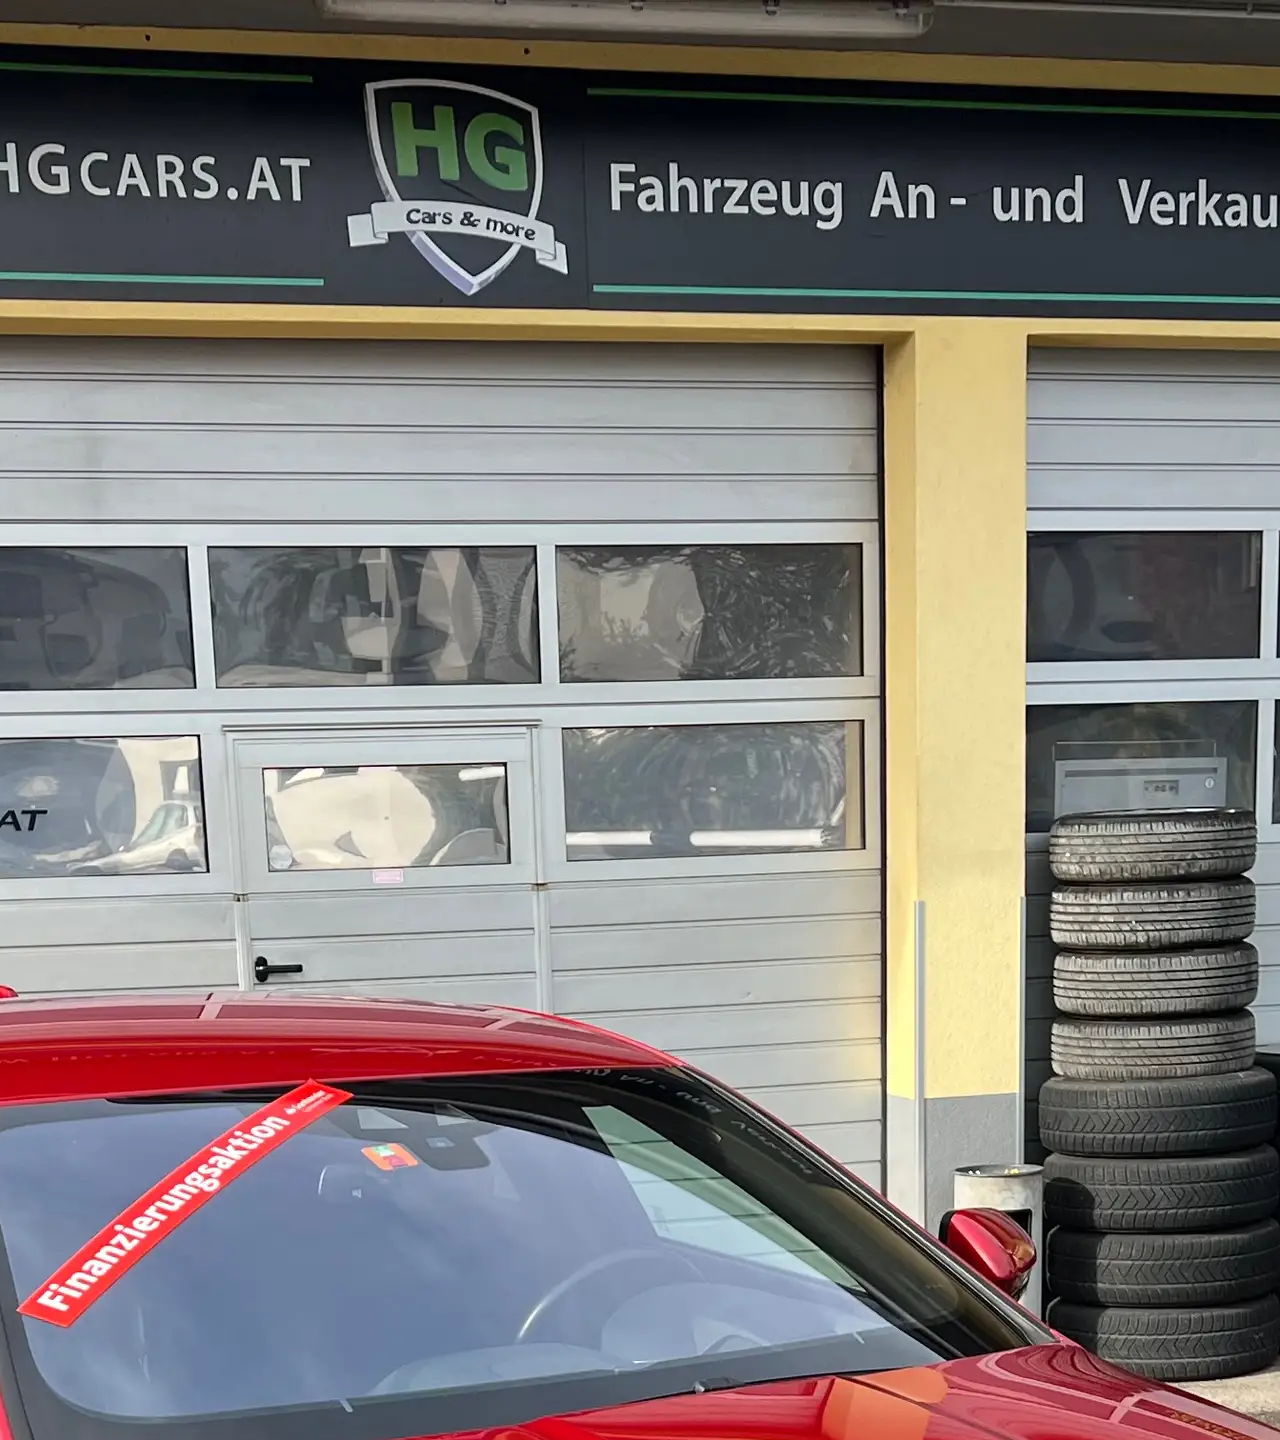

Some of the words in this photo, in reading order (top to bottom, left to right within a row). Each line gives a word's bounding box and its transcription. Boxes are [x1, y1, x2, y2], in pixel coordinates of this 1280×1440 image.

[392, 102, 528, 190] HG
[406, 208, 453, 226] Cars
[460, 211, 481, 227] &
[486, 217, 536, 241] more
[610, 162, 843, 230] Fahrzeug
[993, 174, 1084, 223] und
[36, 1113, 291, 1313] Finanzierungsaktion
